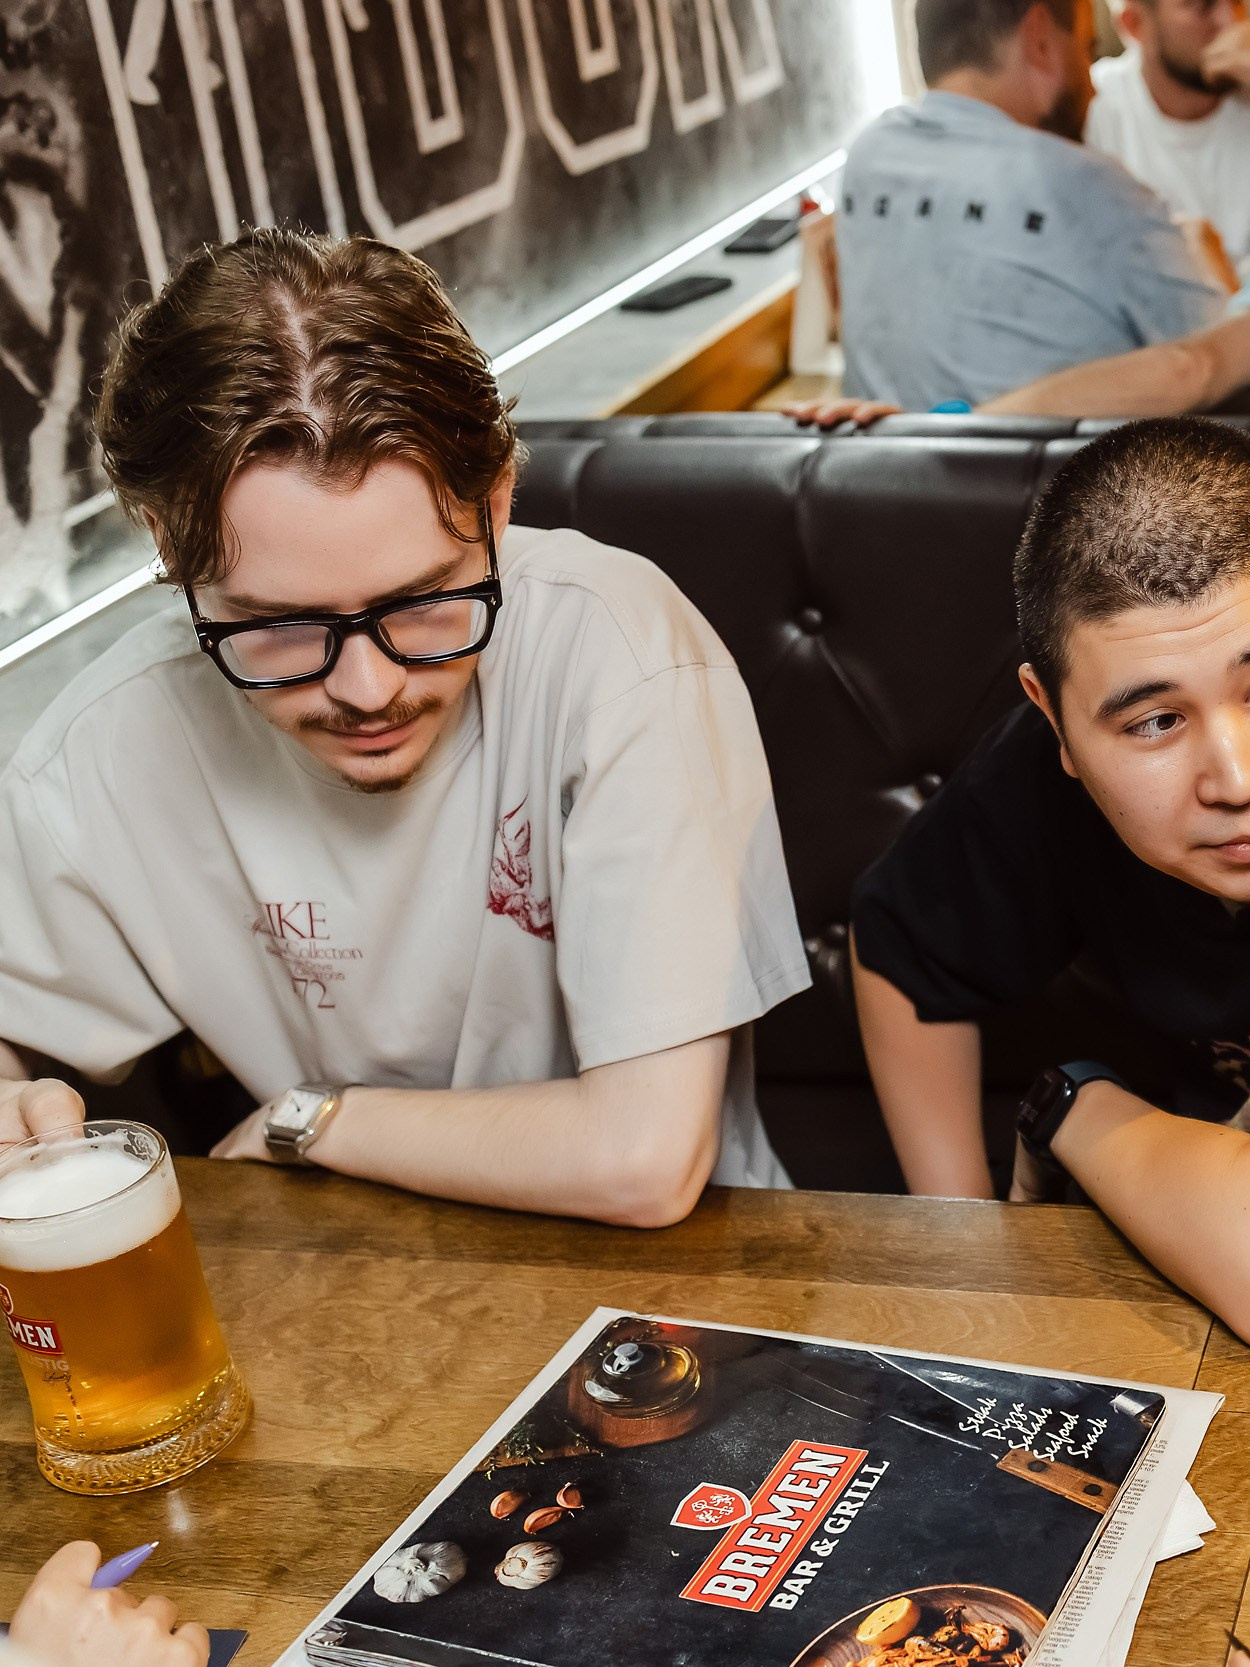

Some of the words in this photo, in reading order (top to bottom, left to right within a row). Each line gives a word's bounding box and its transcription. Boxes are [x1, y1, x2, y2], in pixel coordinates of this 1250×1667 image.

[958, 1397, 998, 1434] Steak
[981, 1402, 1025, 1441] Pizza
[1032, 1410, 1080, 1463] Seafood
[1066, 1418, 1108, 1459] Snack
[823, 1459, 891, 1535] GRILL
[700, 1448, 848, 1602] BREMEN
[809, 1537, 840, 1558] &
[768, 1559, 824, 1611] BAR
